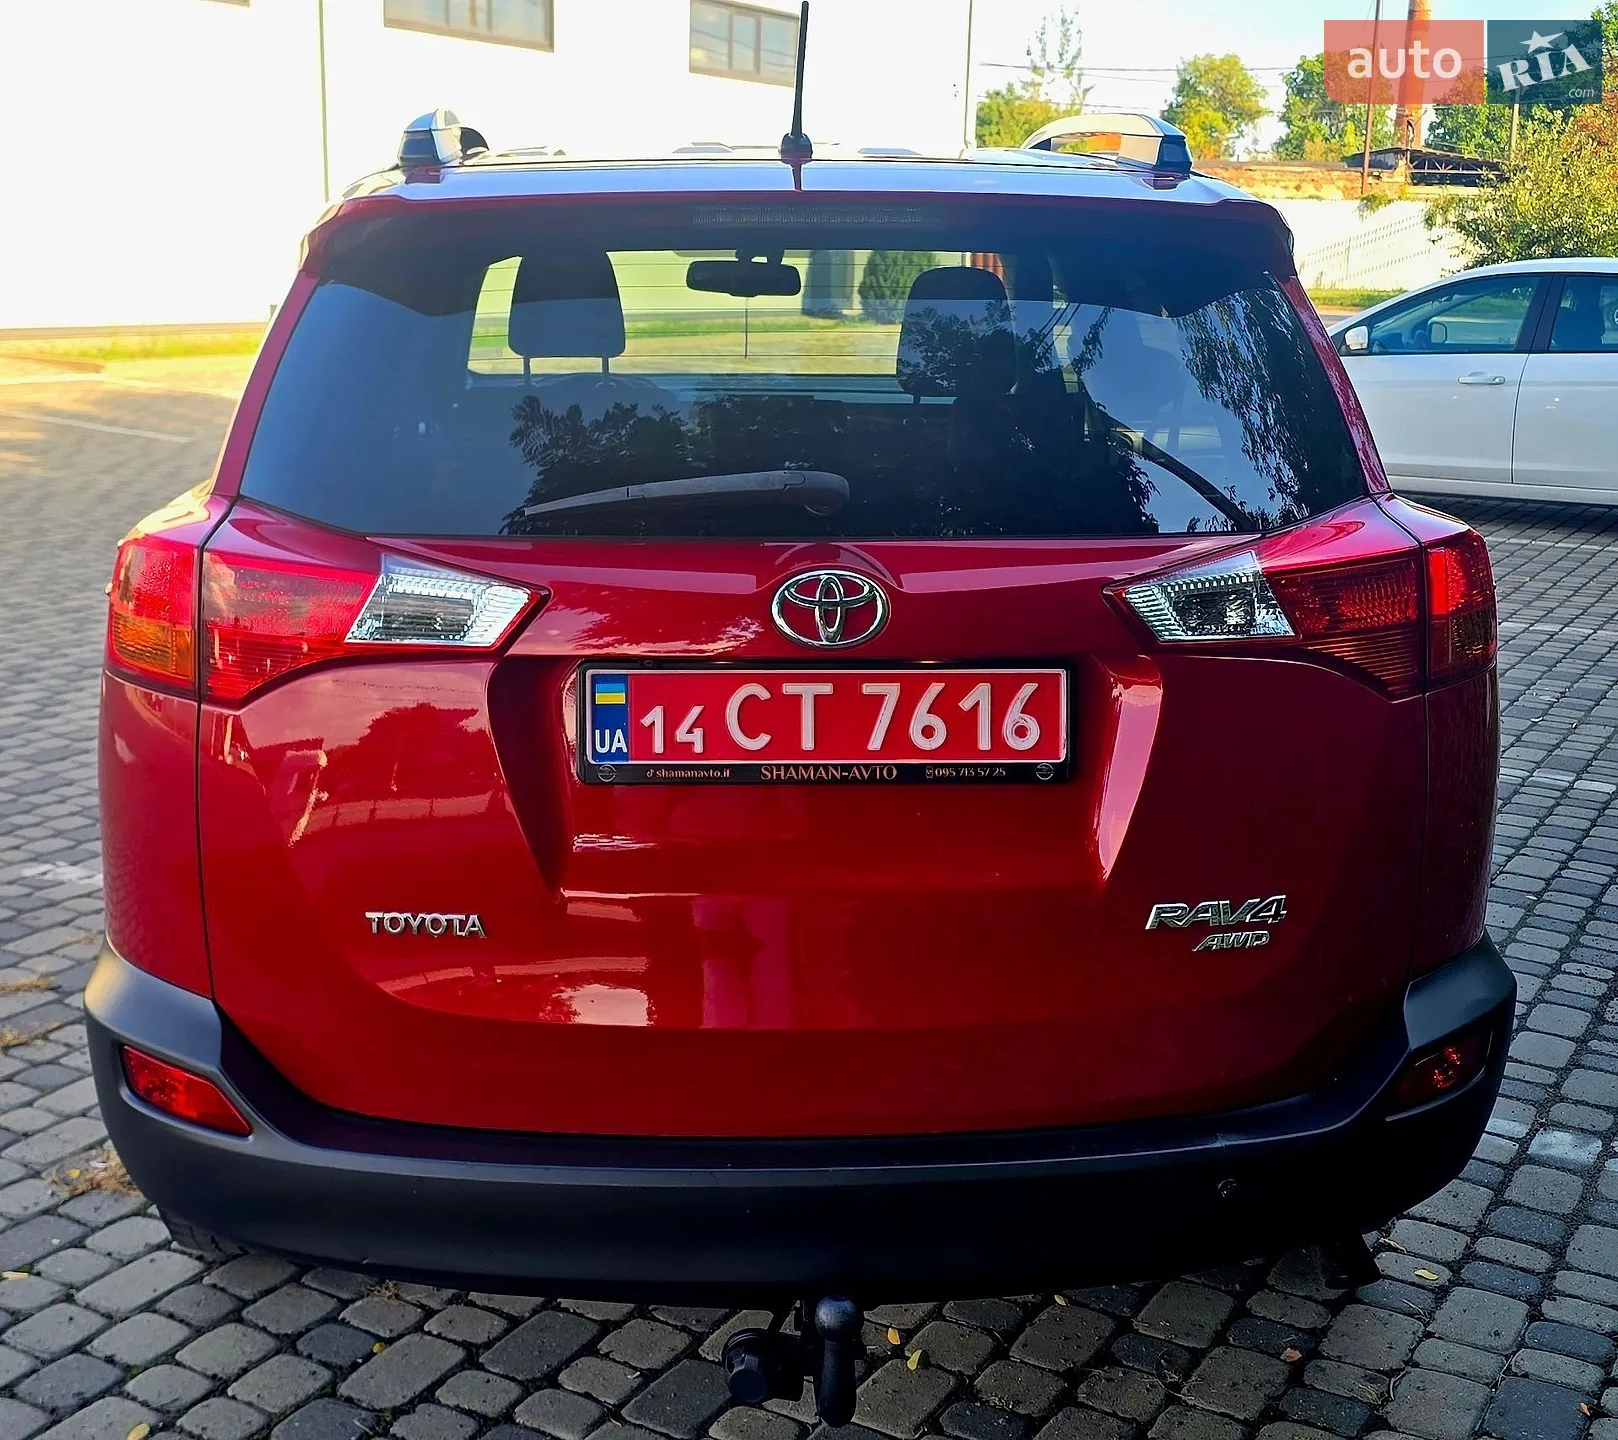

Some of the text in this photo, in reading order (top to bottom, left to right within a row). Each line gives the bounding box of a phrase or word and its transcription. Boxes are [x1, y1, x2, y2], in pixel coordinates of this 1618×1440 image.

[640, 682, 1041, 754] 14 CT 7616
[595, 728, 628, 753] UA
[760, 765, 898, 780] SHAMAN-AVTO
[935, 767, 956, 777] 095
[992, 767, 1006, 777] 25
[365, 911, 487, 938] TOYOTA
[1145, 895, 1287, 930] RAV4
[1192, 930, 1270, 951] AWD
